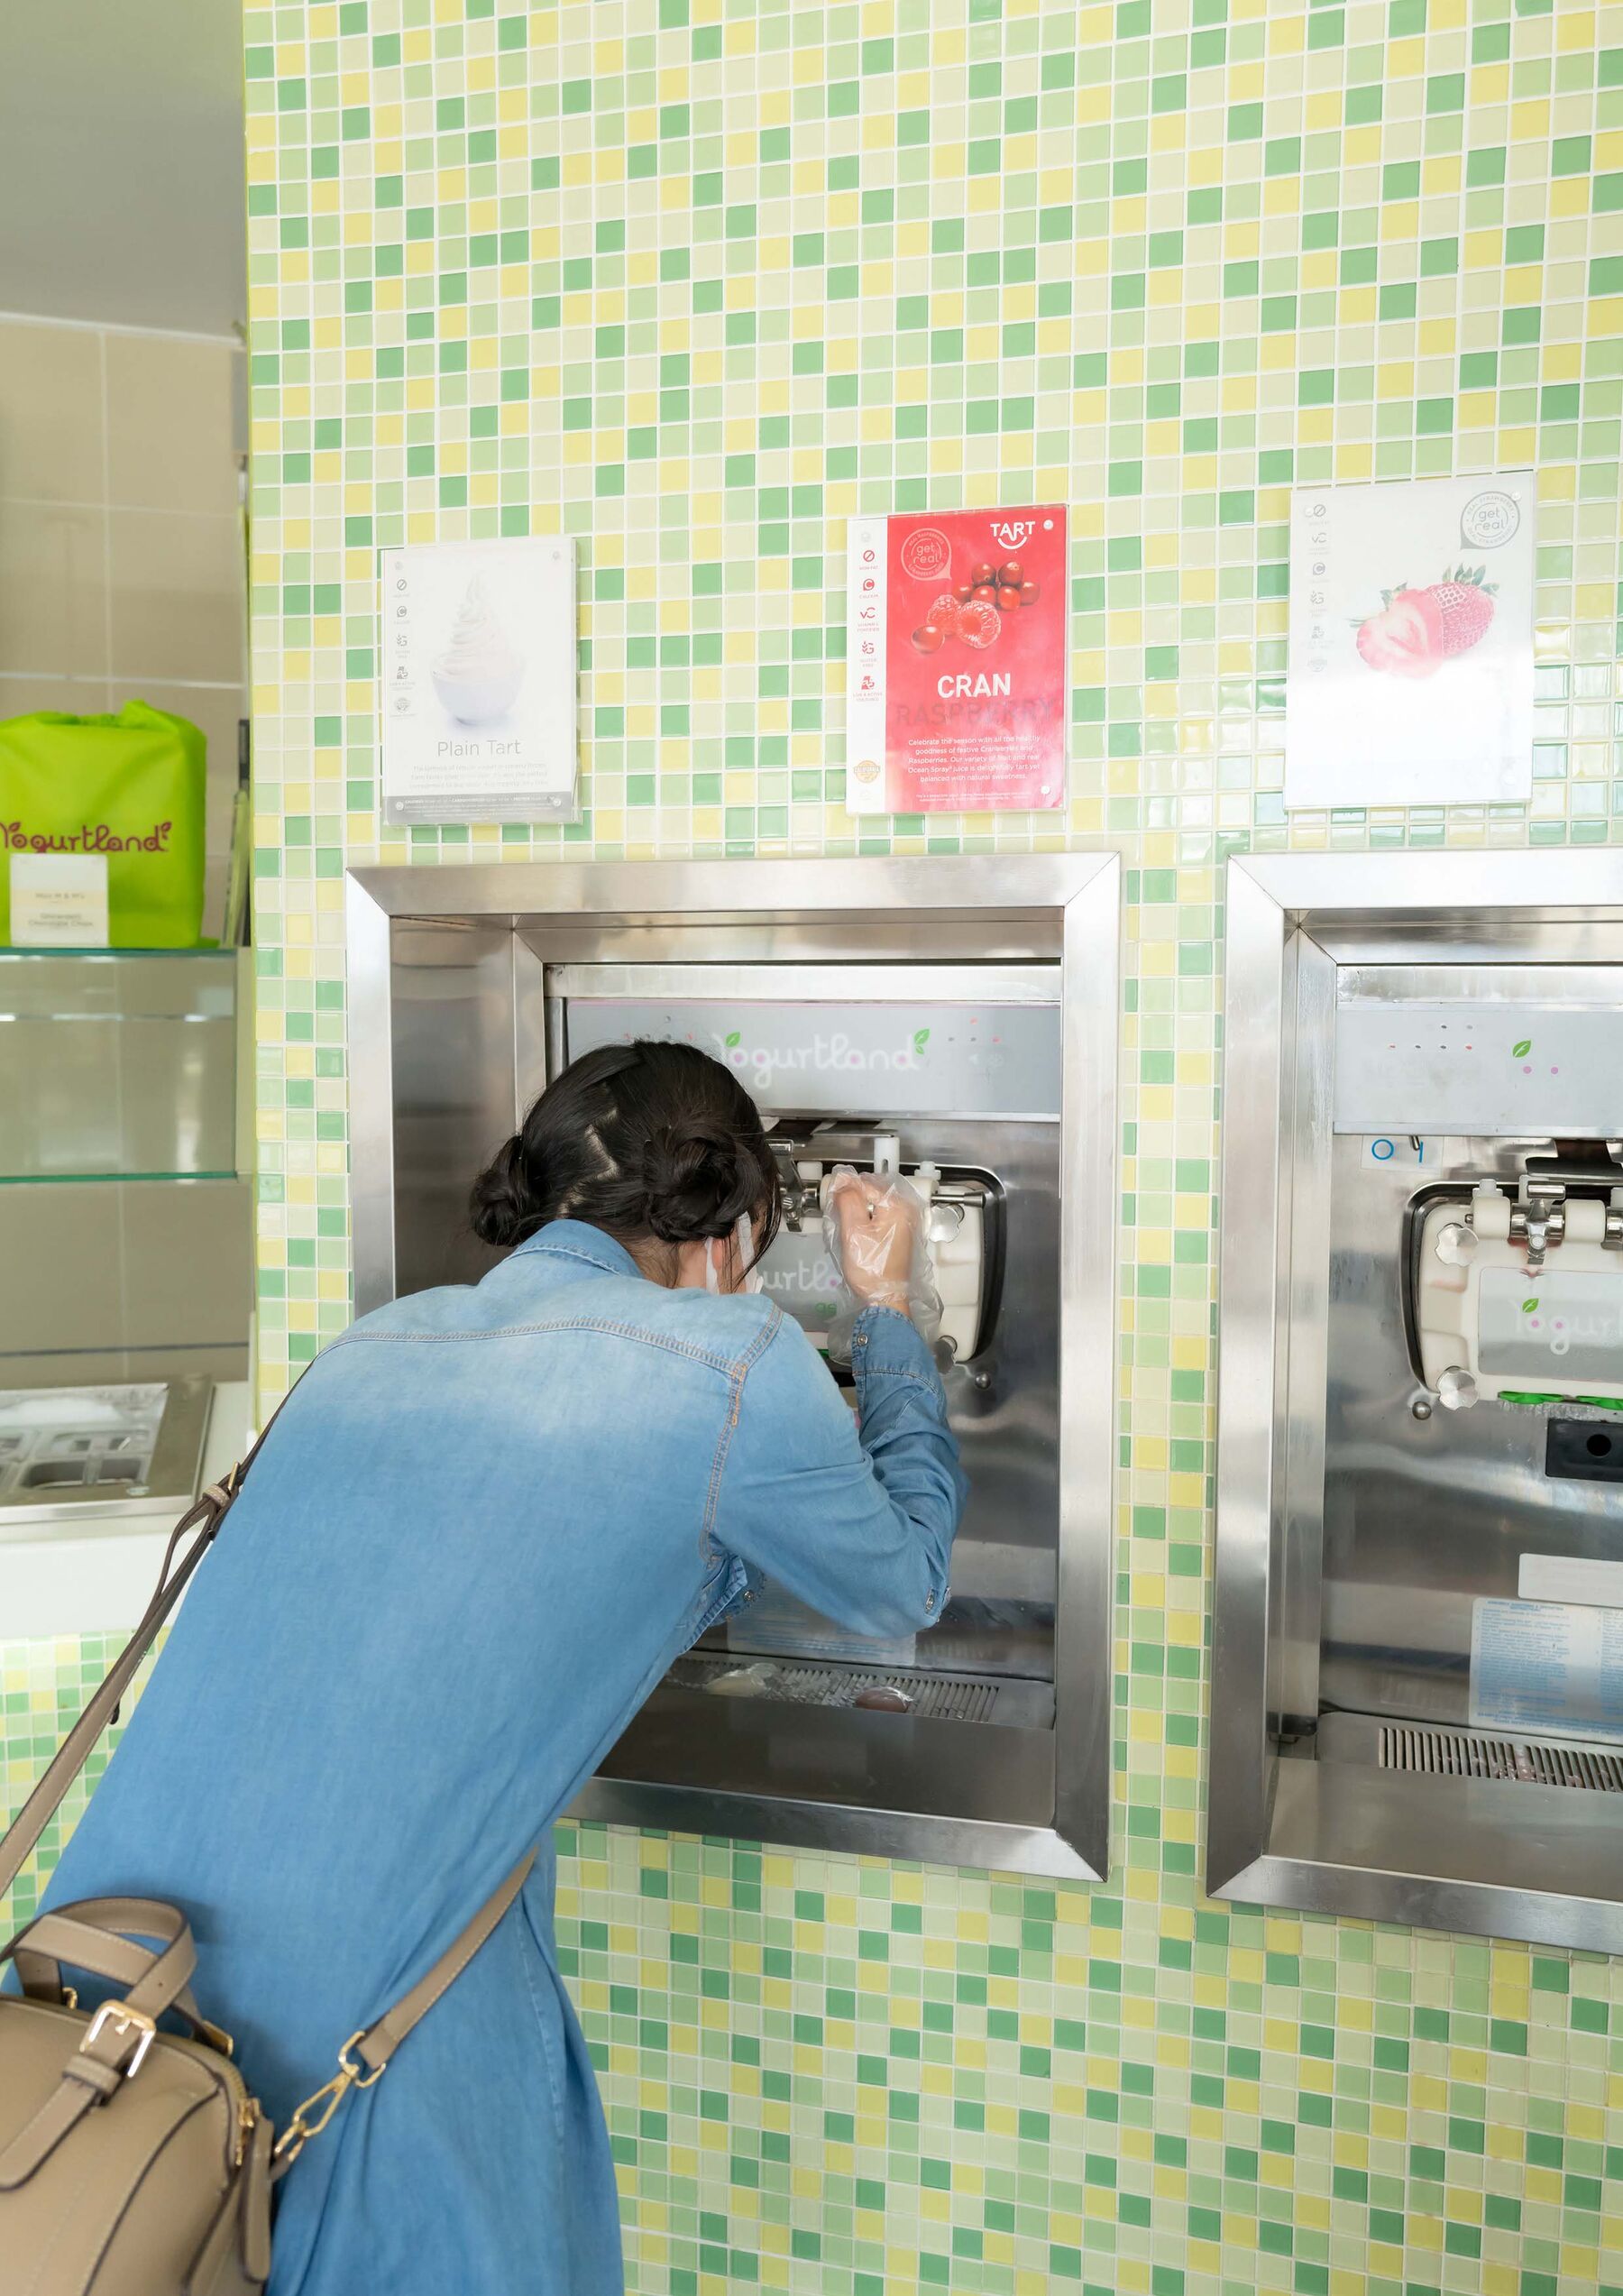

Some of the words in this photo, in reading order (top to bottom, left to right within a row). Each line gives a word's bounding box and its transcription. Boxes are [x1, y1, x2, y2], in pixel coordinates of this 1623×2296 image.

[1479, 506, 1500, 522] get
[990, 520, 1036, 542] TART
[1474, 519, 1506, 531] real
[912, 551, 939, 564] real
[916, 542, 935, 556] get
[937, 672, 1011, 698] CRAN
[437, 740, 480, 757] Plain
[487, 739, 521, 756] Tart
[0, 822, 168, 854] Yogurtland
[712, 1033, 921, 1089] Yogurtland
